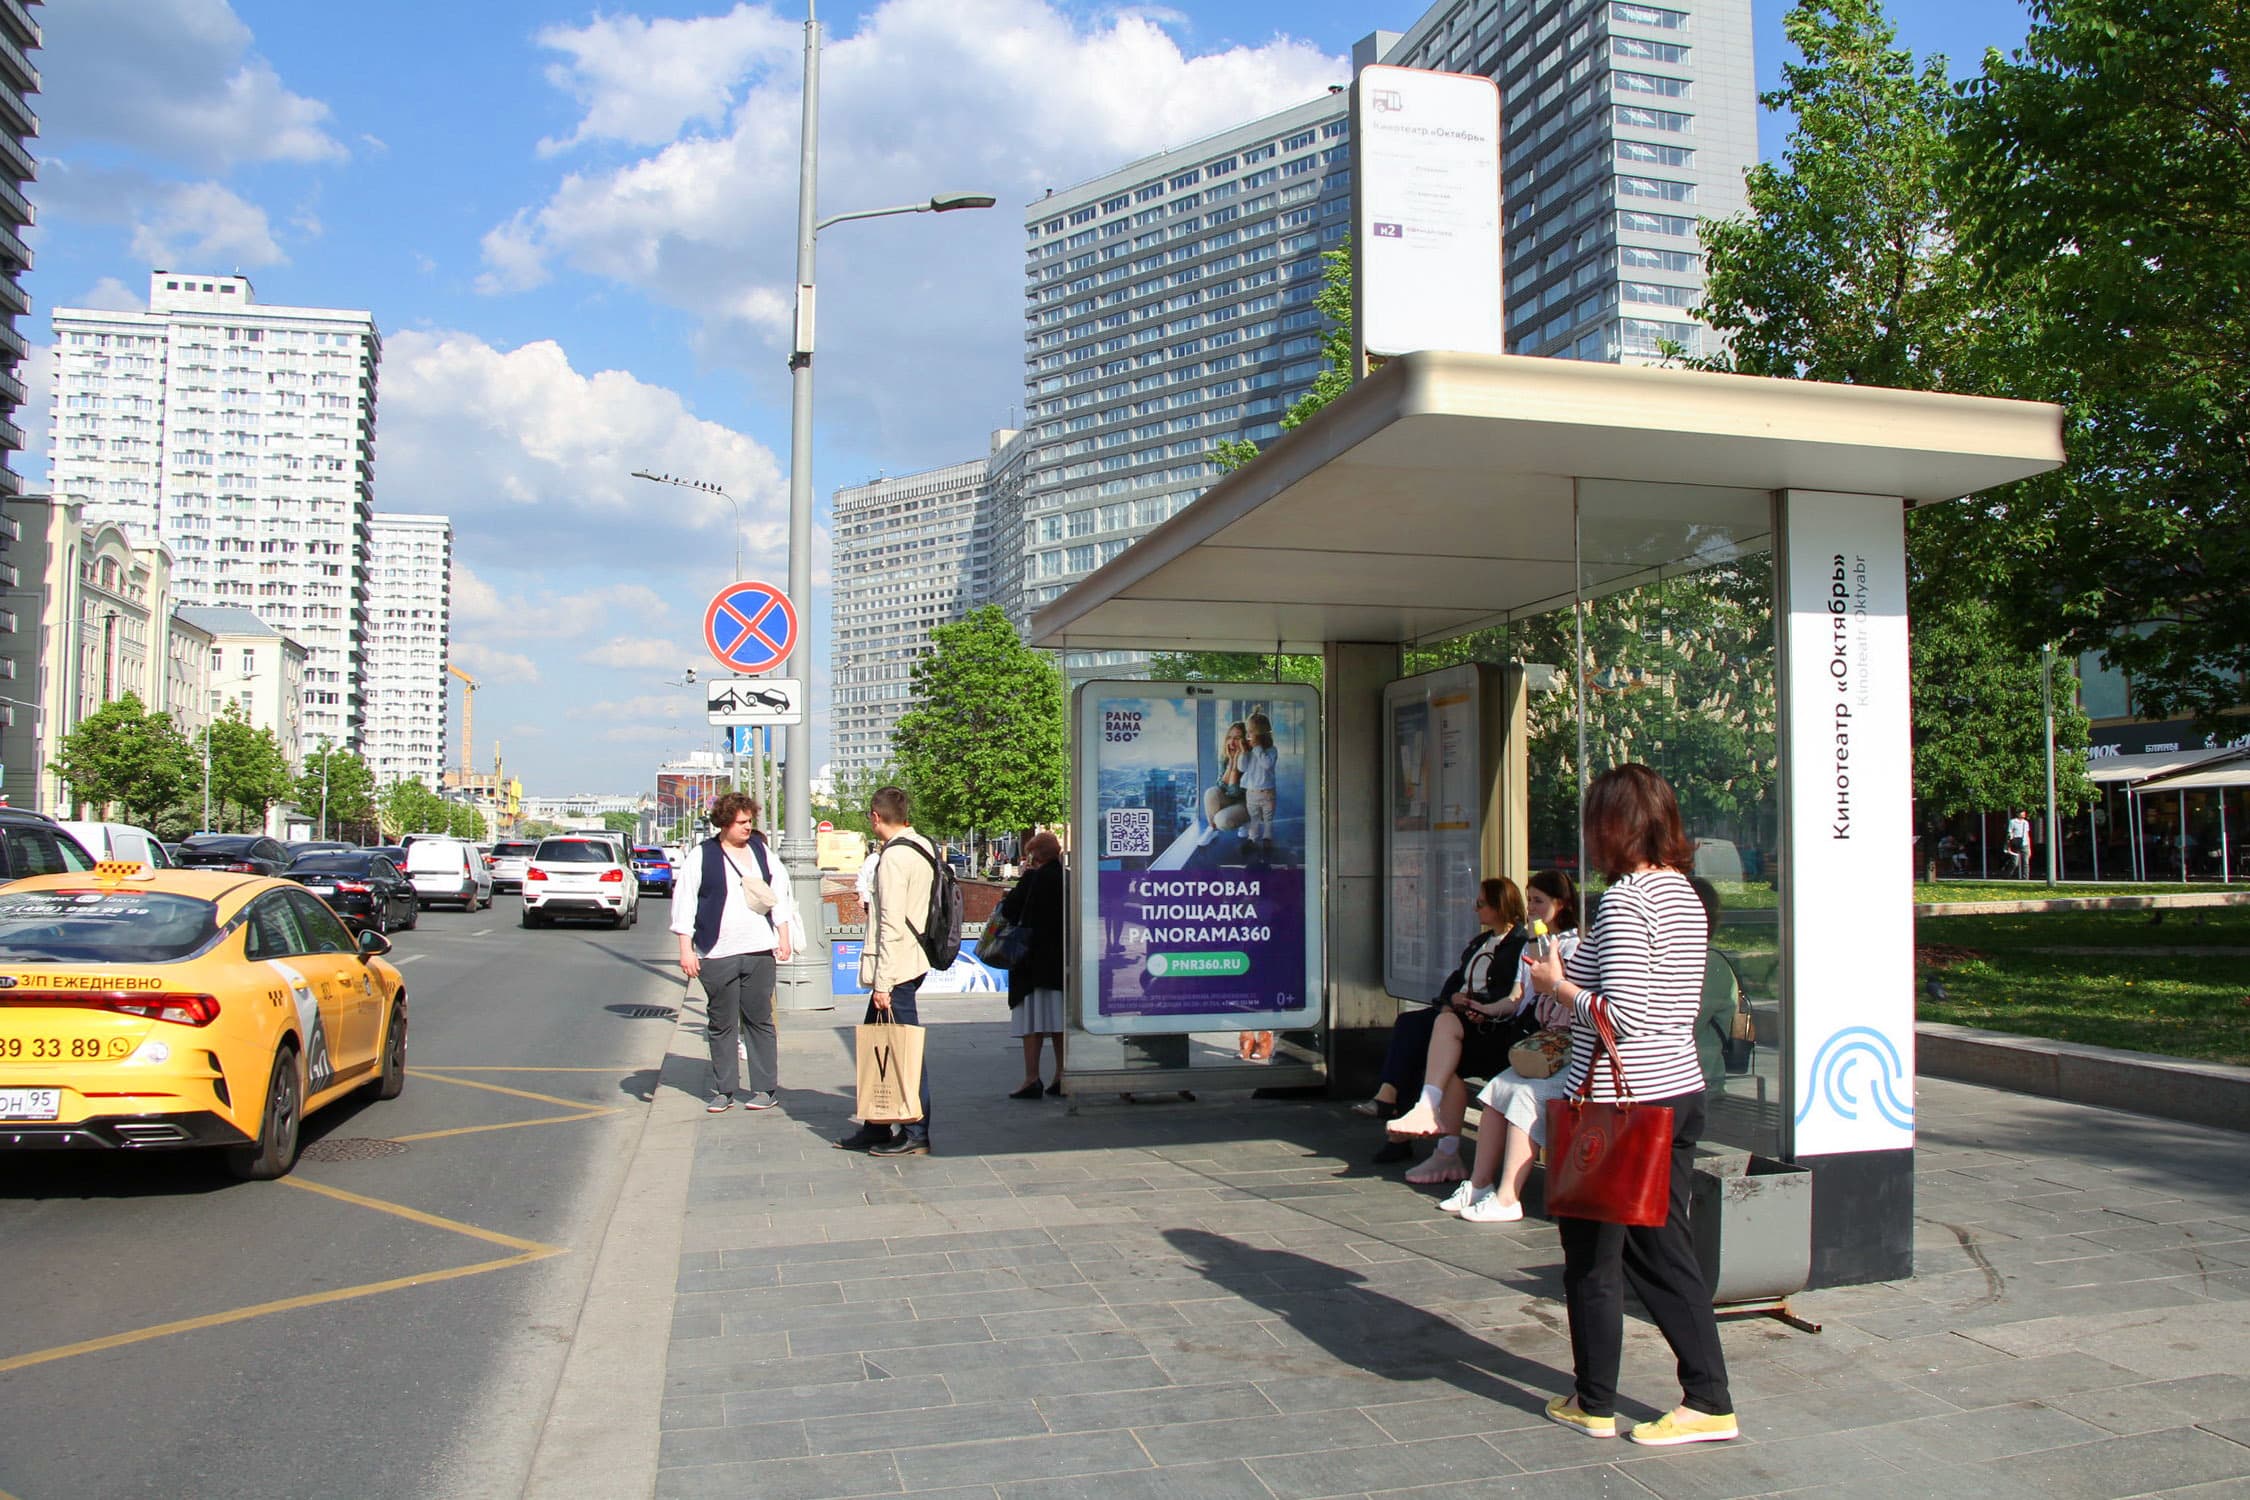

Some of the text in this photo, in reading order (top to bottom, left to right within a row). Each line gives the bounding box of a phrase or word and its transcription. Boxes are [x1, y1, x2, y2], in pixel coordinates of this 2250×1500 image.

[1855, 629, 1870, 707] Kinoteatr
[1828, 554, 1852, 839] Кинотеатр «Октябрь»
[1105, 711, 1142, 721] PANO
[1105, 721, 1142, 731] RAMA
[1105, 732, 1132, 742] 360
[1139, 881, 1260, 897] СМОТРОВАЯ
[1141, 903, 1258, 922] ПЛОЩАДКА
[1128, 926, 1271, 944] PANORAMA360
[1171, 959, 1241, 971] PNR360.RU
[21, 975, 162, 990] З/П ЕЖЕДНЕВНО
[32, 1038, 61, 1058] 33
[71, 1038, 101, 1058] 89
[30, 1091, 51, 1106] 95
